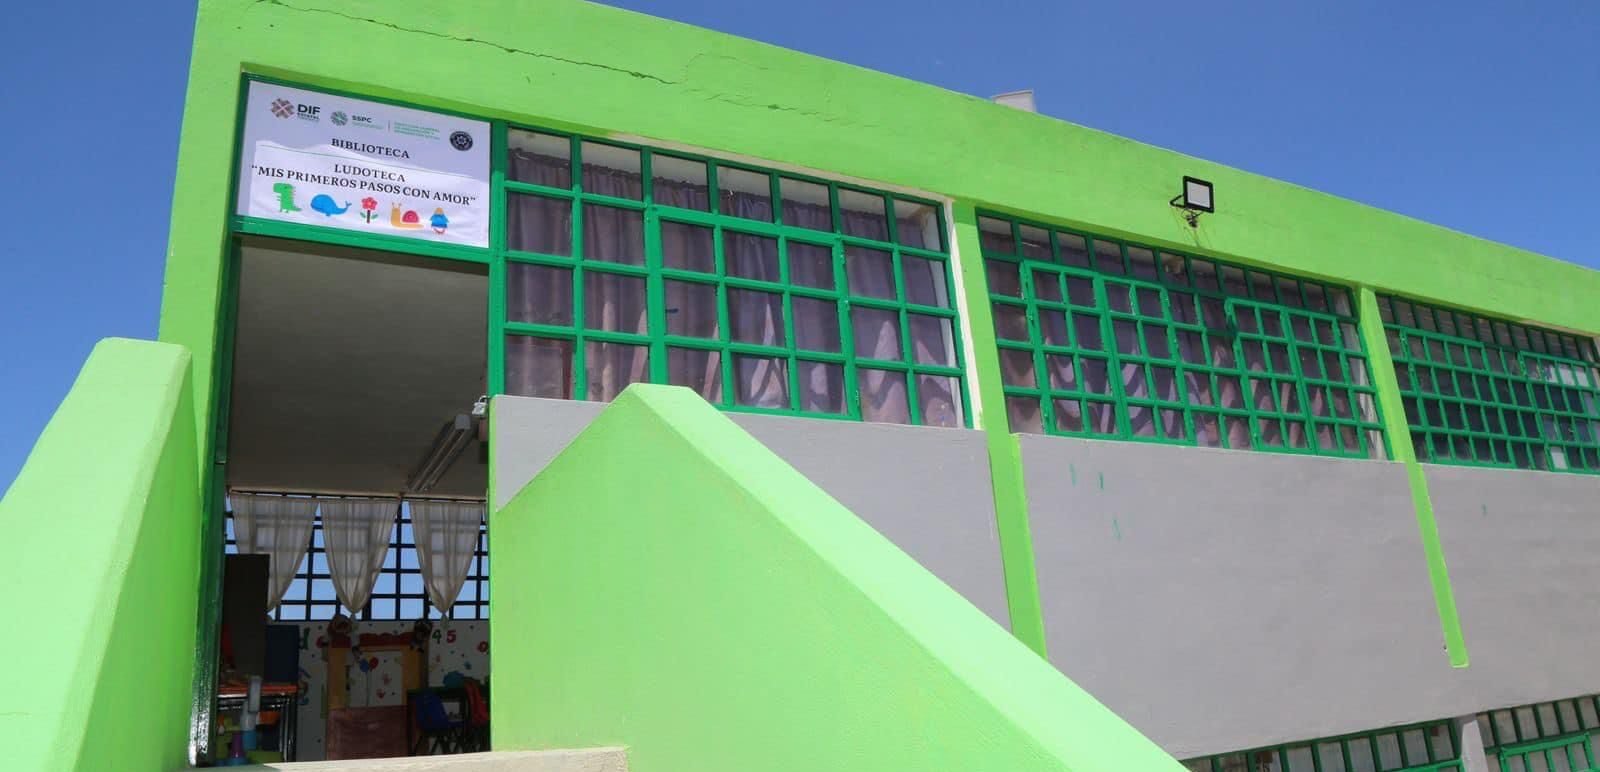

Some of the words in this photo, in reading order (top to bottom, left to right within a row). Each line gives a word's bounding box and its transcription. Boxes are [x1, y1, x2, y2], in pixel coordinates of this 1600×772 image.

[297, 104, 320, 114] DIF
[352, 115, 372, 123] SSPC
[331, 138, 409, 159] BIBLIOTECA
[335, 164, 405, 182] LUDOTECA
[287, 170, 357, 188] PRIMEROS
[360, 181, 400, 194] PASOS
[403, 187, 430, 199] CON
